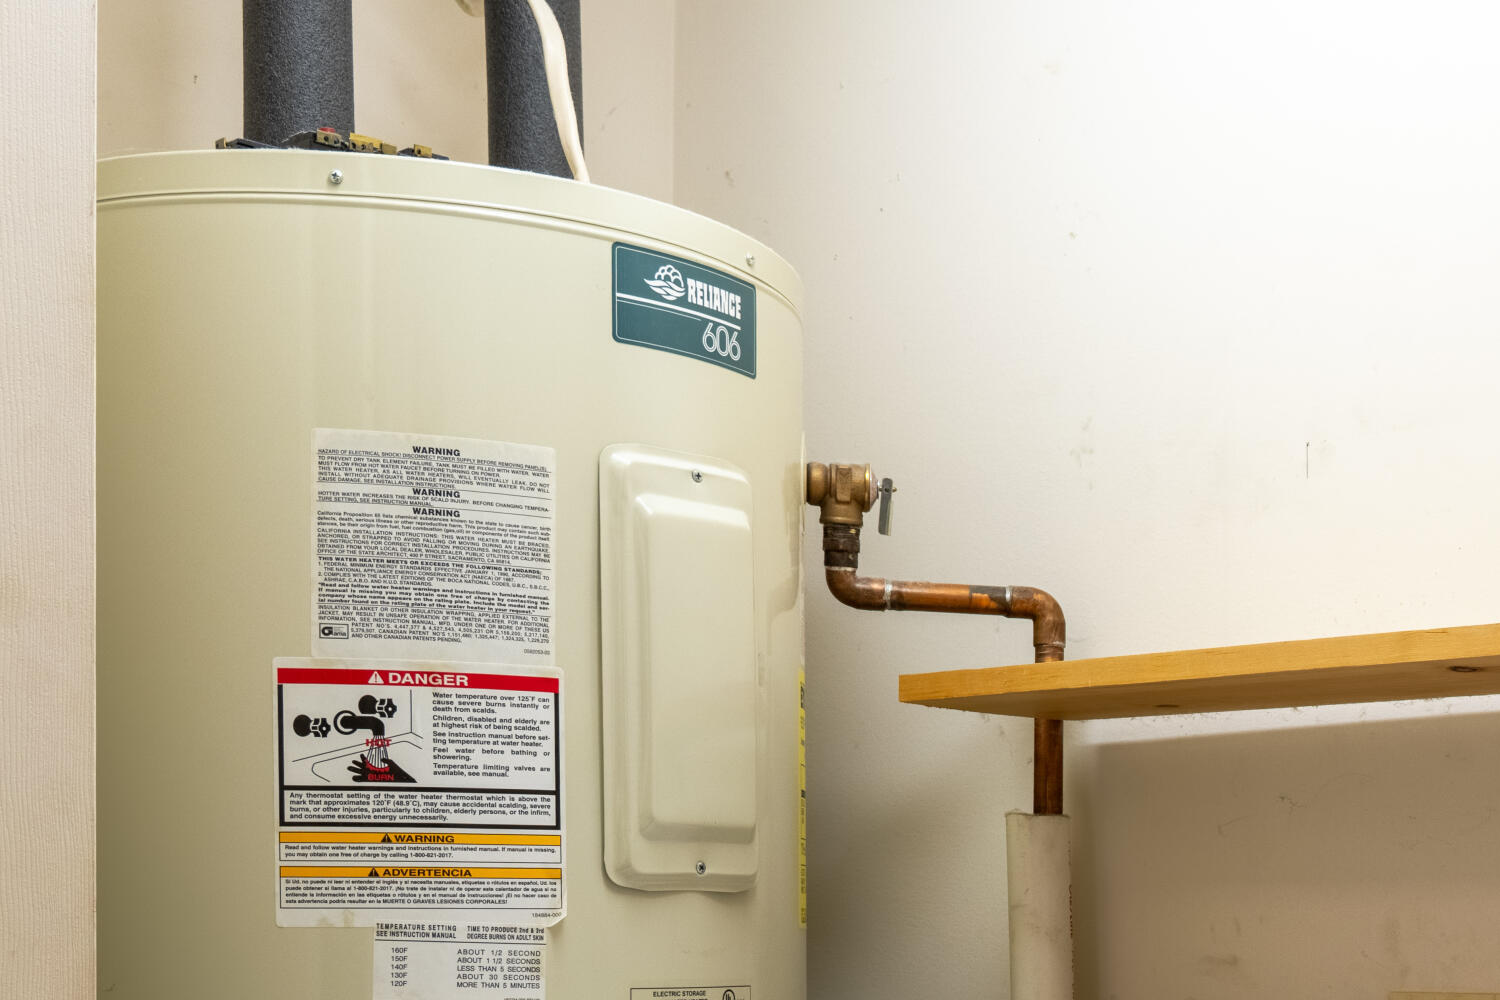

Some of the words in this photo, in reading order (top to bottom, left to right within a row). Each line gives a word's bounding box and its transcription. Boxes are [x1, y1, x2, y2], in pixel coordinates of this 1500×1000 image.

[687, 278, 741, 319] RELIANCE
[703, 323, 741, 361] 606
[413, 446, 460, 456] WARNING
[413, 488, 460, 498] WARNING
[413, 507, 460, 517] WARNING
[389, 672, 468, 686] DANGER
[366, 739, 392, 747] HOT
[394, 835, 454, 843] WARNING
[383, 869, 472, 877] ADVERTENCIA
